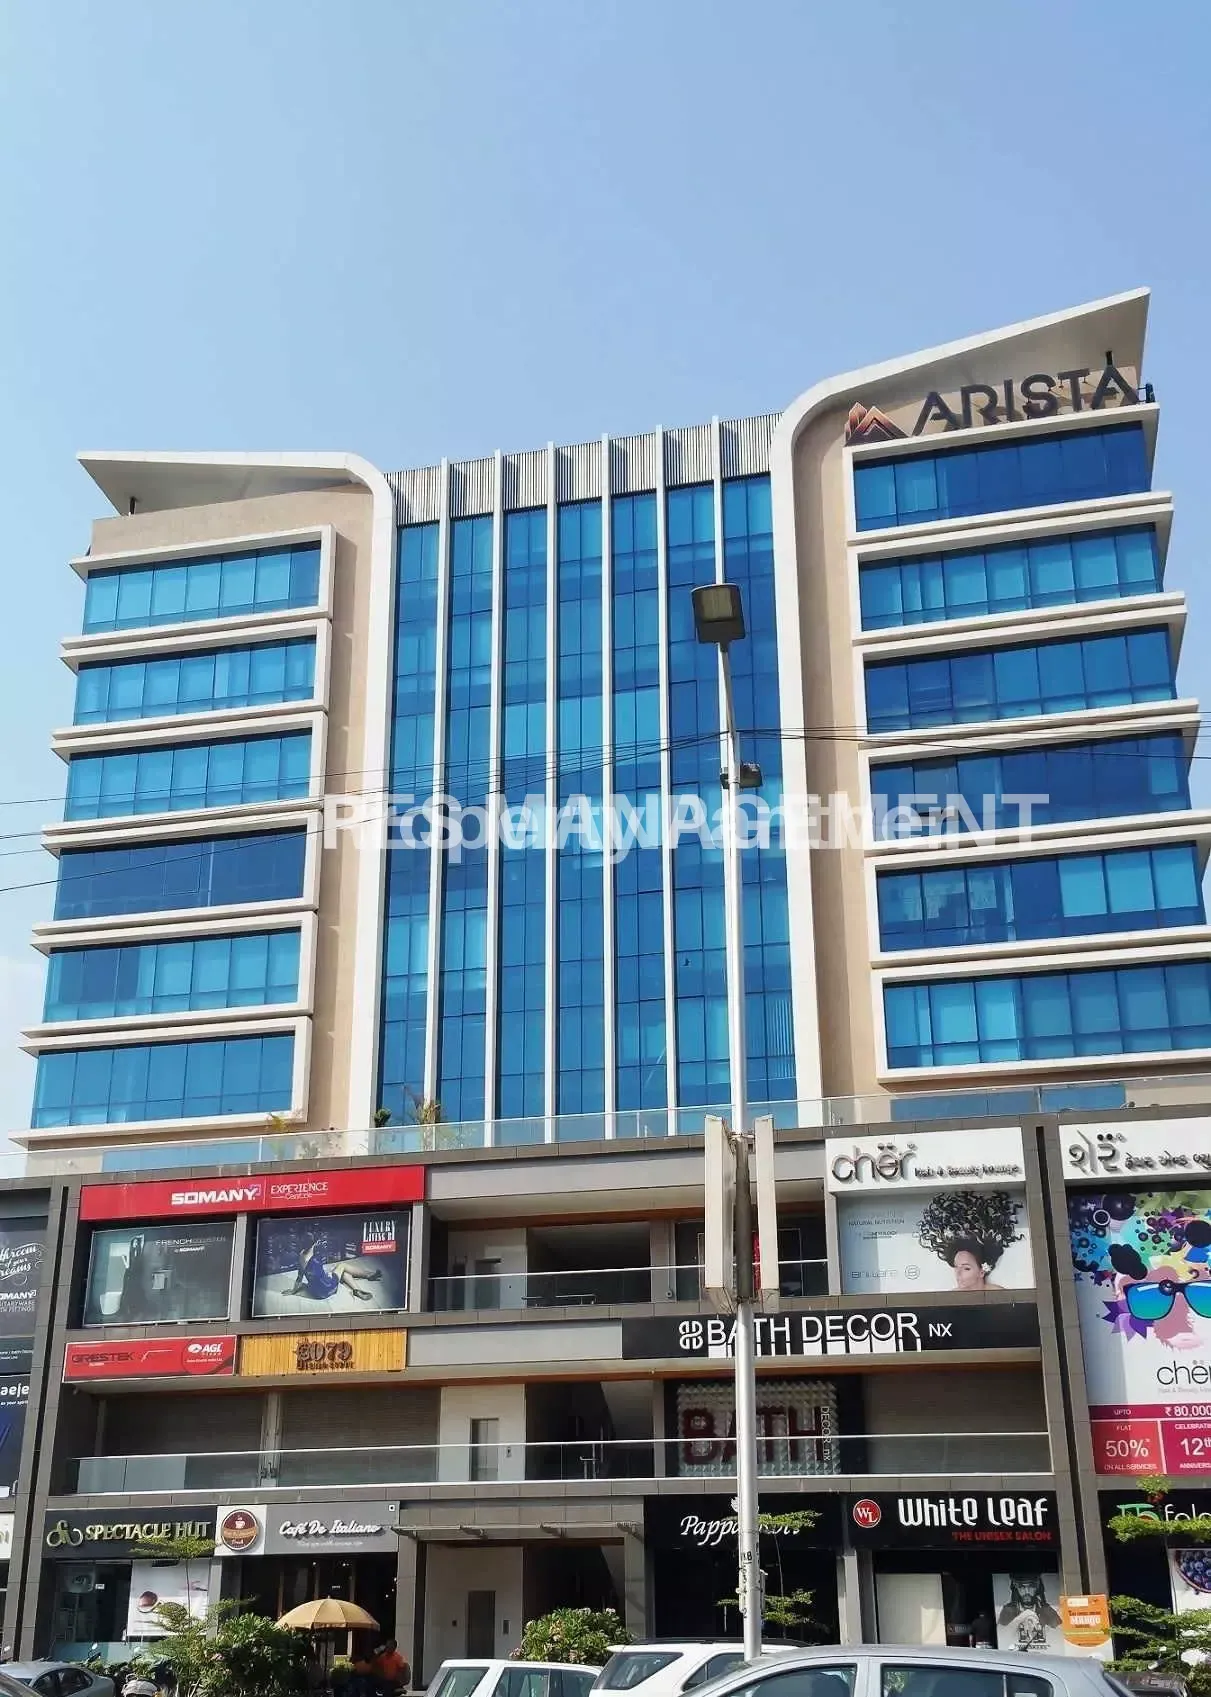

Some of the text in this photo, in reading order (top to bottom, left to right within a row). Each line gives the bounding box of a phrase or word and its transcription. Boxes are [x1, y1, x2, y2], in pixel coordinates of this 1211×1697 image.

[912, 361, 1140, 437] ARISTA
[171, 1187, 257, 1206] SOMANY
[271, 1182, 329, 1194] EXPERIENCE
[155, 1238, 193, 1246] FRENCH
[802, 1312, 921, 1343] DECOR
[928, 1322, 953, 1338] NX
[201, 1343, 223, 1353] AGL
[1113, 1408, 1132, 1416] UPTO
[821, 1406, 833, 1443] DECOR
[897, 1498, 978, 1527] White
[85, 1523, 172, 1541] SPECTACLE
[175, 1521, 212, 1539] HUT
[309, 1519, 327, 1534] De
[951, 1530, 1052, 1541] THE UNISEX SALON
